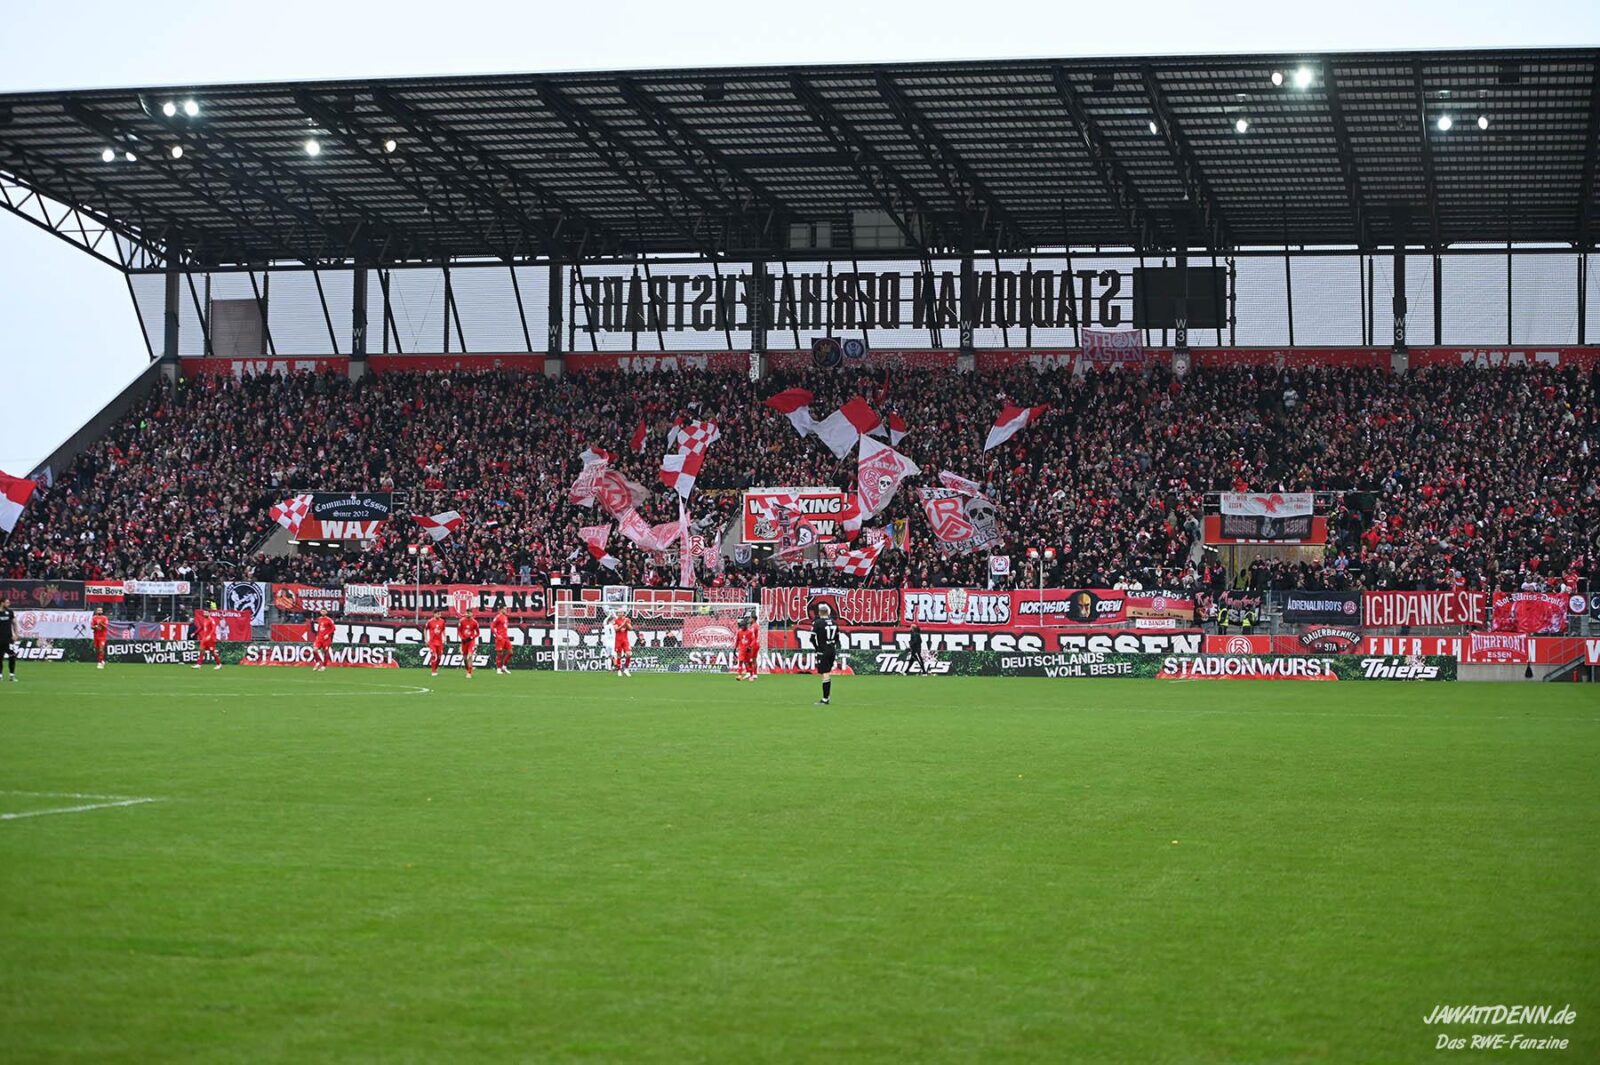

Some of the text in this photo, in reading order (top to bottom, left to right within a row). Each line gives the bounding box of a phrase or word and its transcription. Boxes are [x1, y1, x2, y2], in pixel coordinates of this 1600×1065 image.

[548, 325, 559, 335] W
[961, 320, 972, 330] W
[1176, 319, 1187, 329] W
[1394, 318, 1405, 328] W
[962, 333, 970, 345] 2
[1177, 330, 1185, 342] 3
[1395, 329, 1404, 341] 3
[1082, 347, 1143, 362] KASTEN
[314, 498, 389, 514] Commando Essen
[353, 510, 371, 518] 2012
[389, 589, 543, 612] RUDE FANS
[760, 587, 899, 623] JUNGE ESSENER
[904, 592, 1010, 624] FREAKS
[1018, 600, 1123, 614] NORTHSIDE CREW
[1287, 596, 1343, 612] ADRENALIN BOYS
[1458, 591, 1484, 625] SIE
[825, 625, 837, 640] 17
[1302, 628, 1361, 645] DAUERBRENNER
[107, 641, 196, 656] DEUTSCHLANDS
[1324, 643, 1338, 652] 97A
[1471, 633, 1527, 655] RUHRFRONT
[144, 652, 180, 665] WOHL
[1002, 652, 1105, 669] DEUTSCHLANDS
[1045, 662, 1132, 678] WOHL BESTE
[1164, 657, 1334, 678] STADIONWURST
[1361, 658, 1440, 679] Thiers
